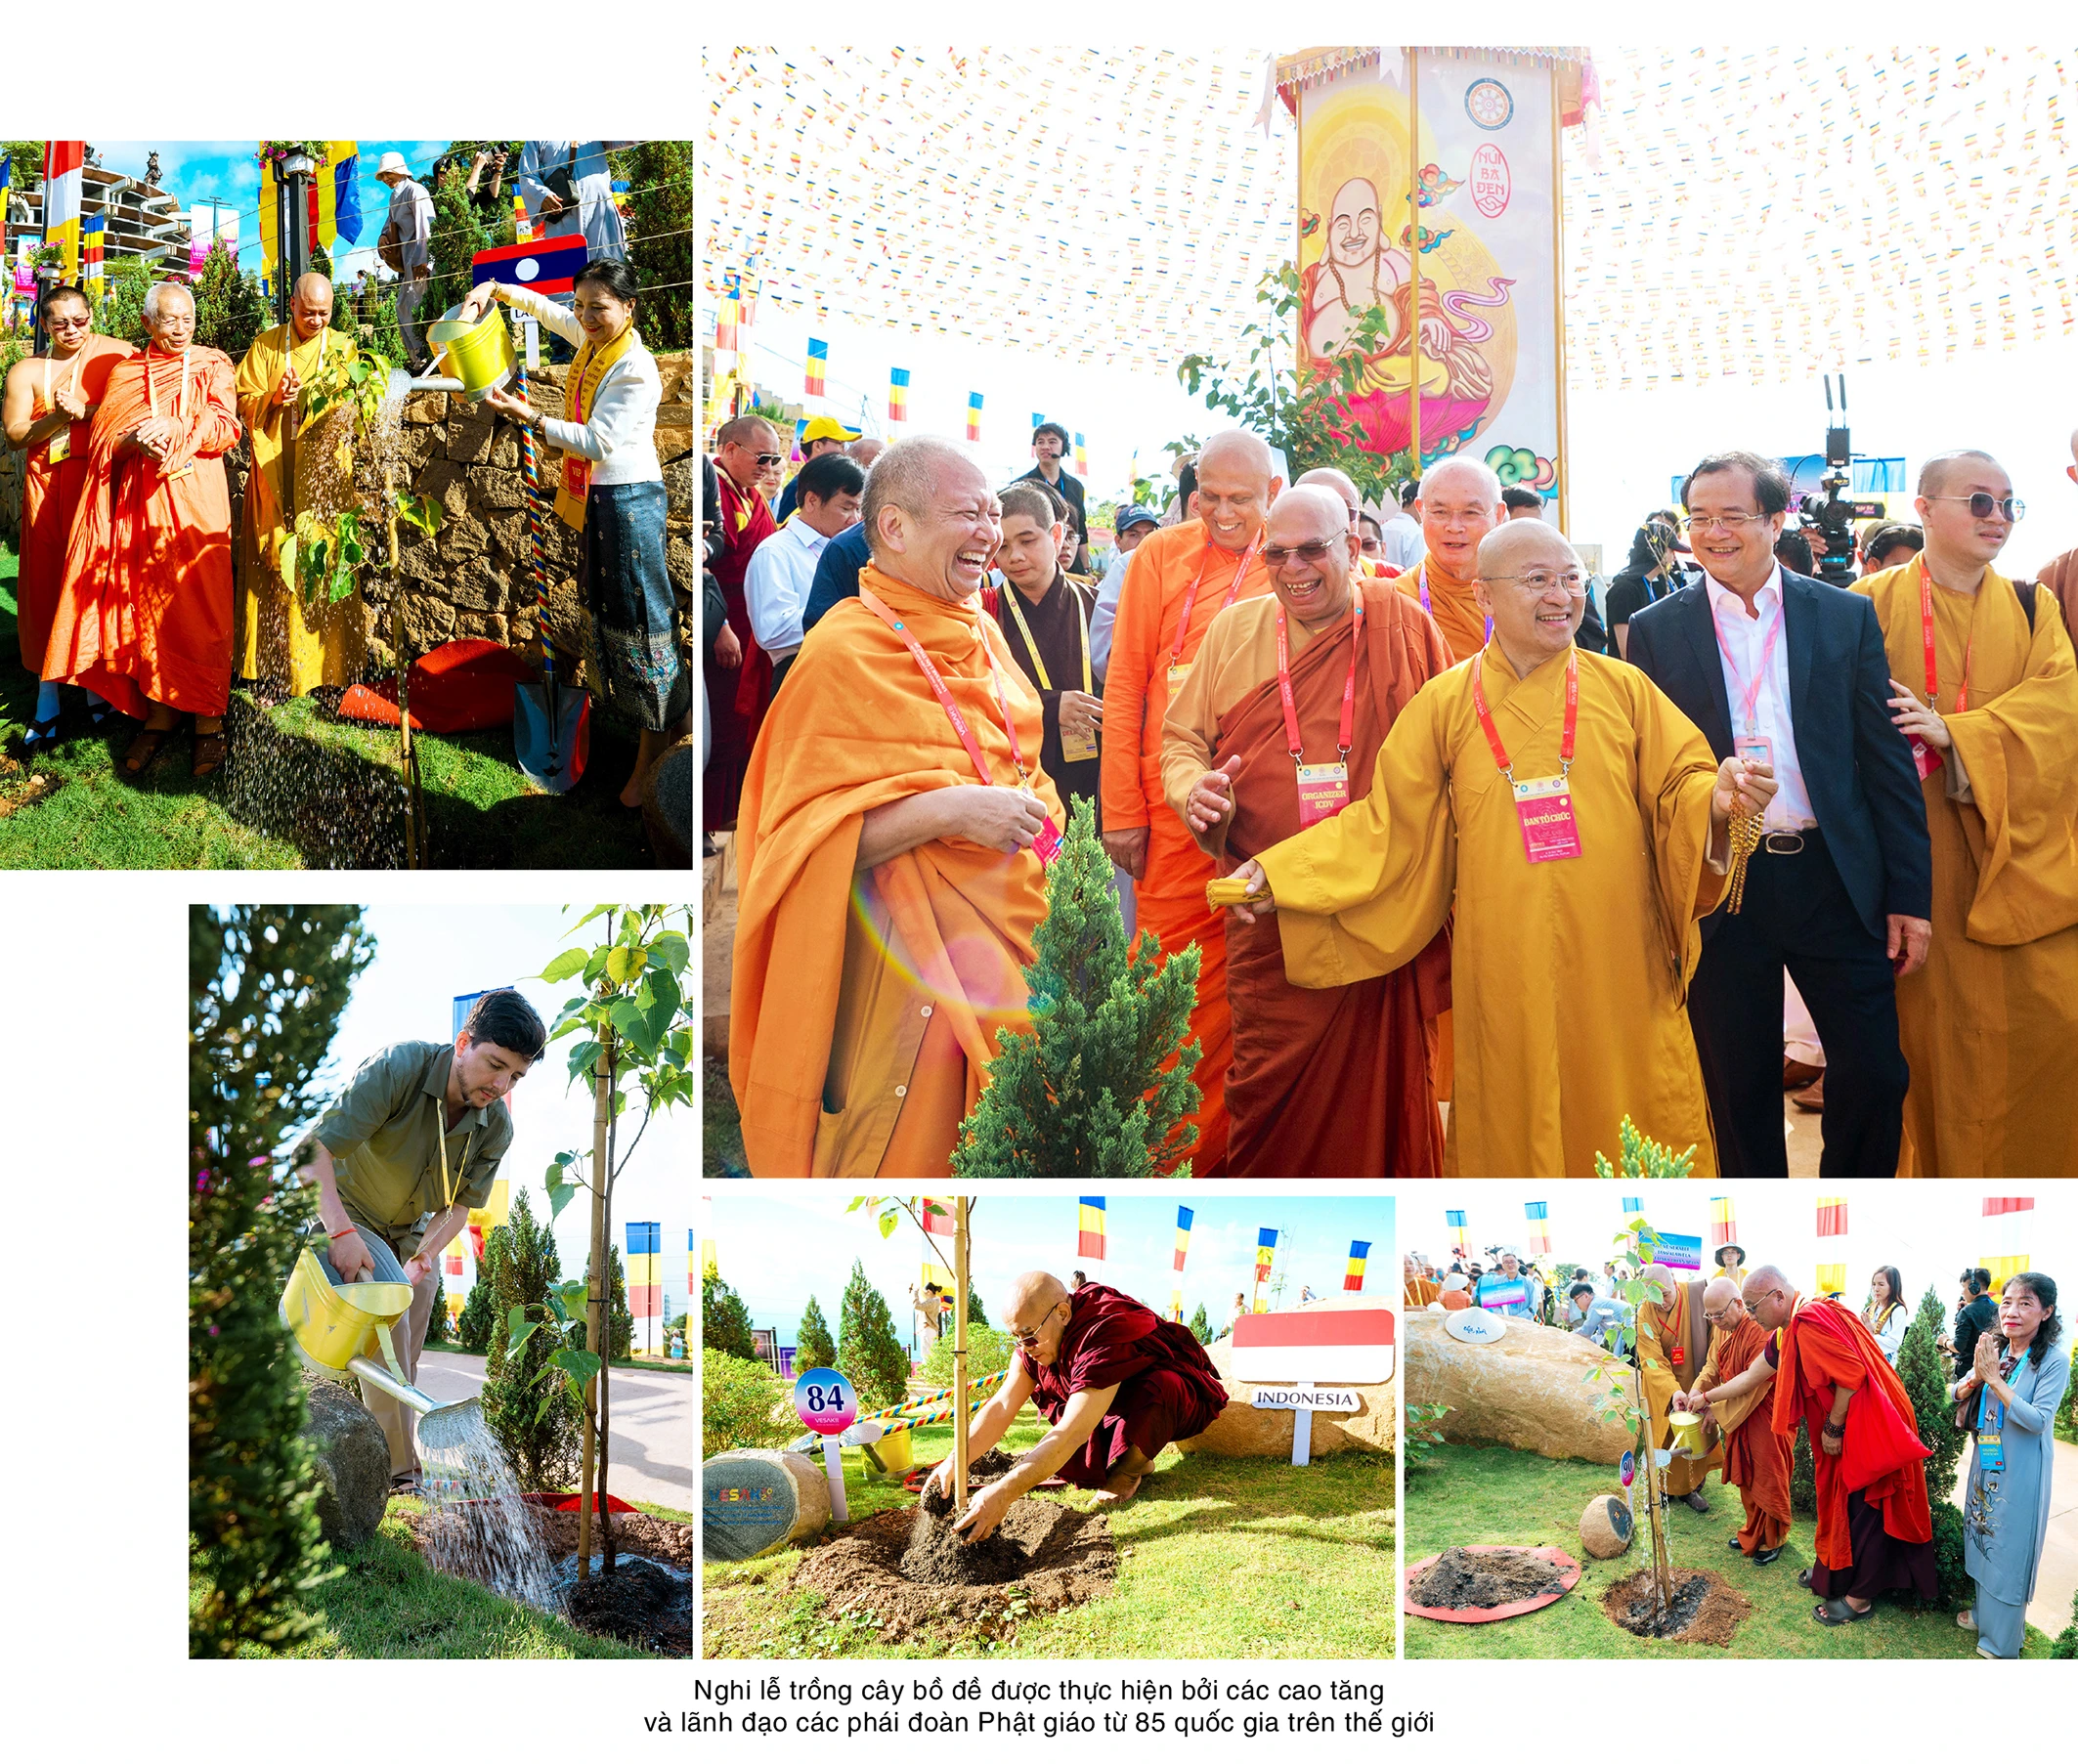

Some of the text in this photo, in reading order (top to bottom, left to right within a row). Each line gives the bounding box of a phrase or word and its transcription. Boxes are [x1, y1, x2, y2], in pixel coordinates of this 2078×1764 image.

[1477, 182, 1505, 195] ĐEN
[1302, 790, 1346, 800] ORGANIZER
[1315, 799, 1334, 809] ICDV
[806, 1385, 844, 1412] 84
[1257, 1392, 1353, 1406] INDONESIA
[709, 1487, 761, 1502] VESAK
